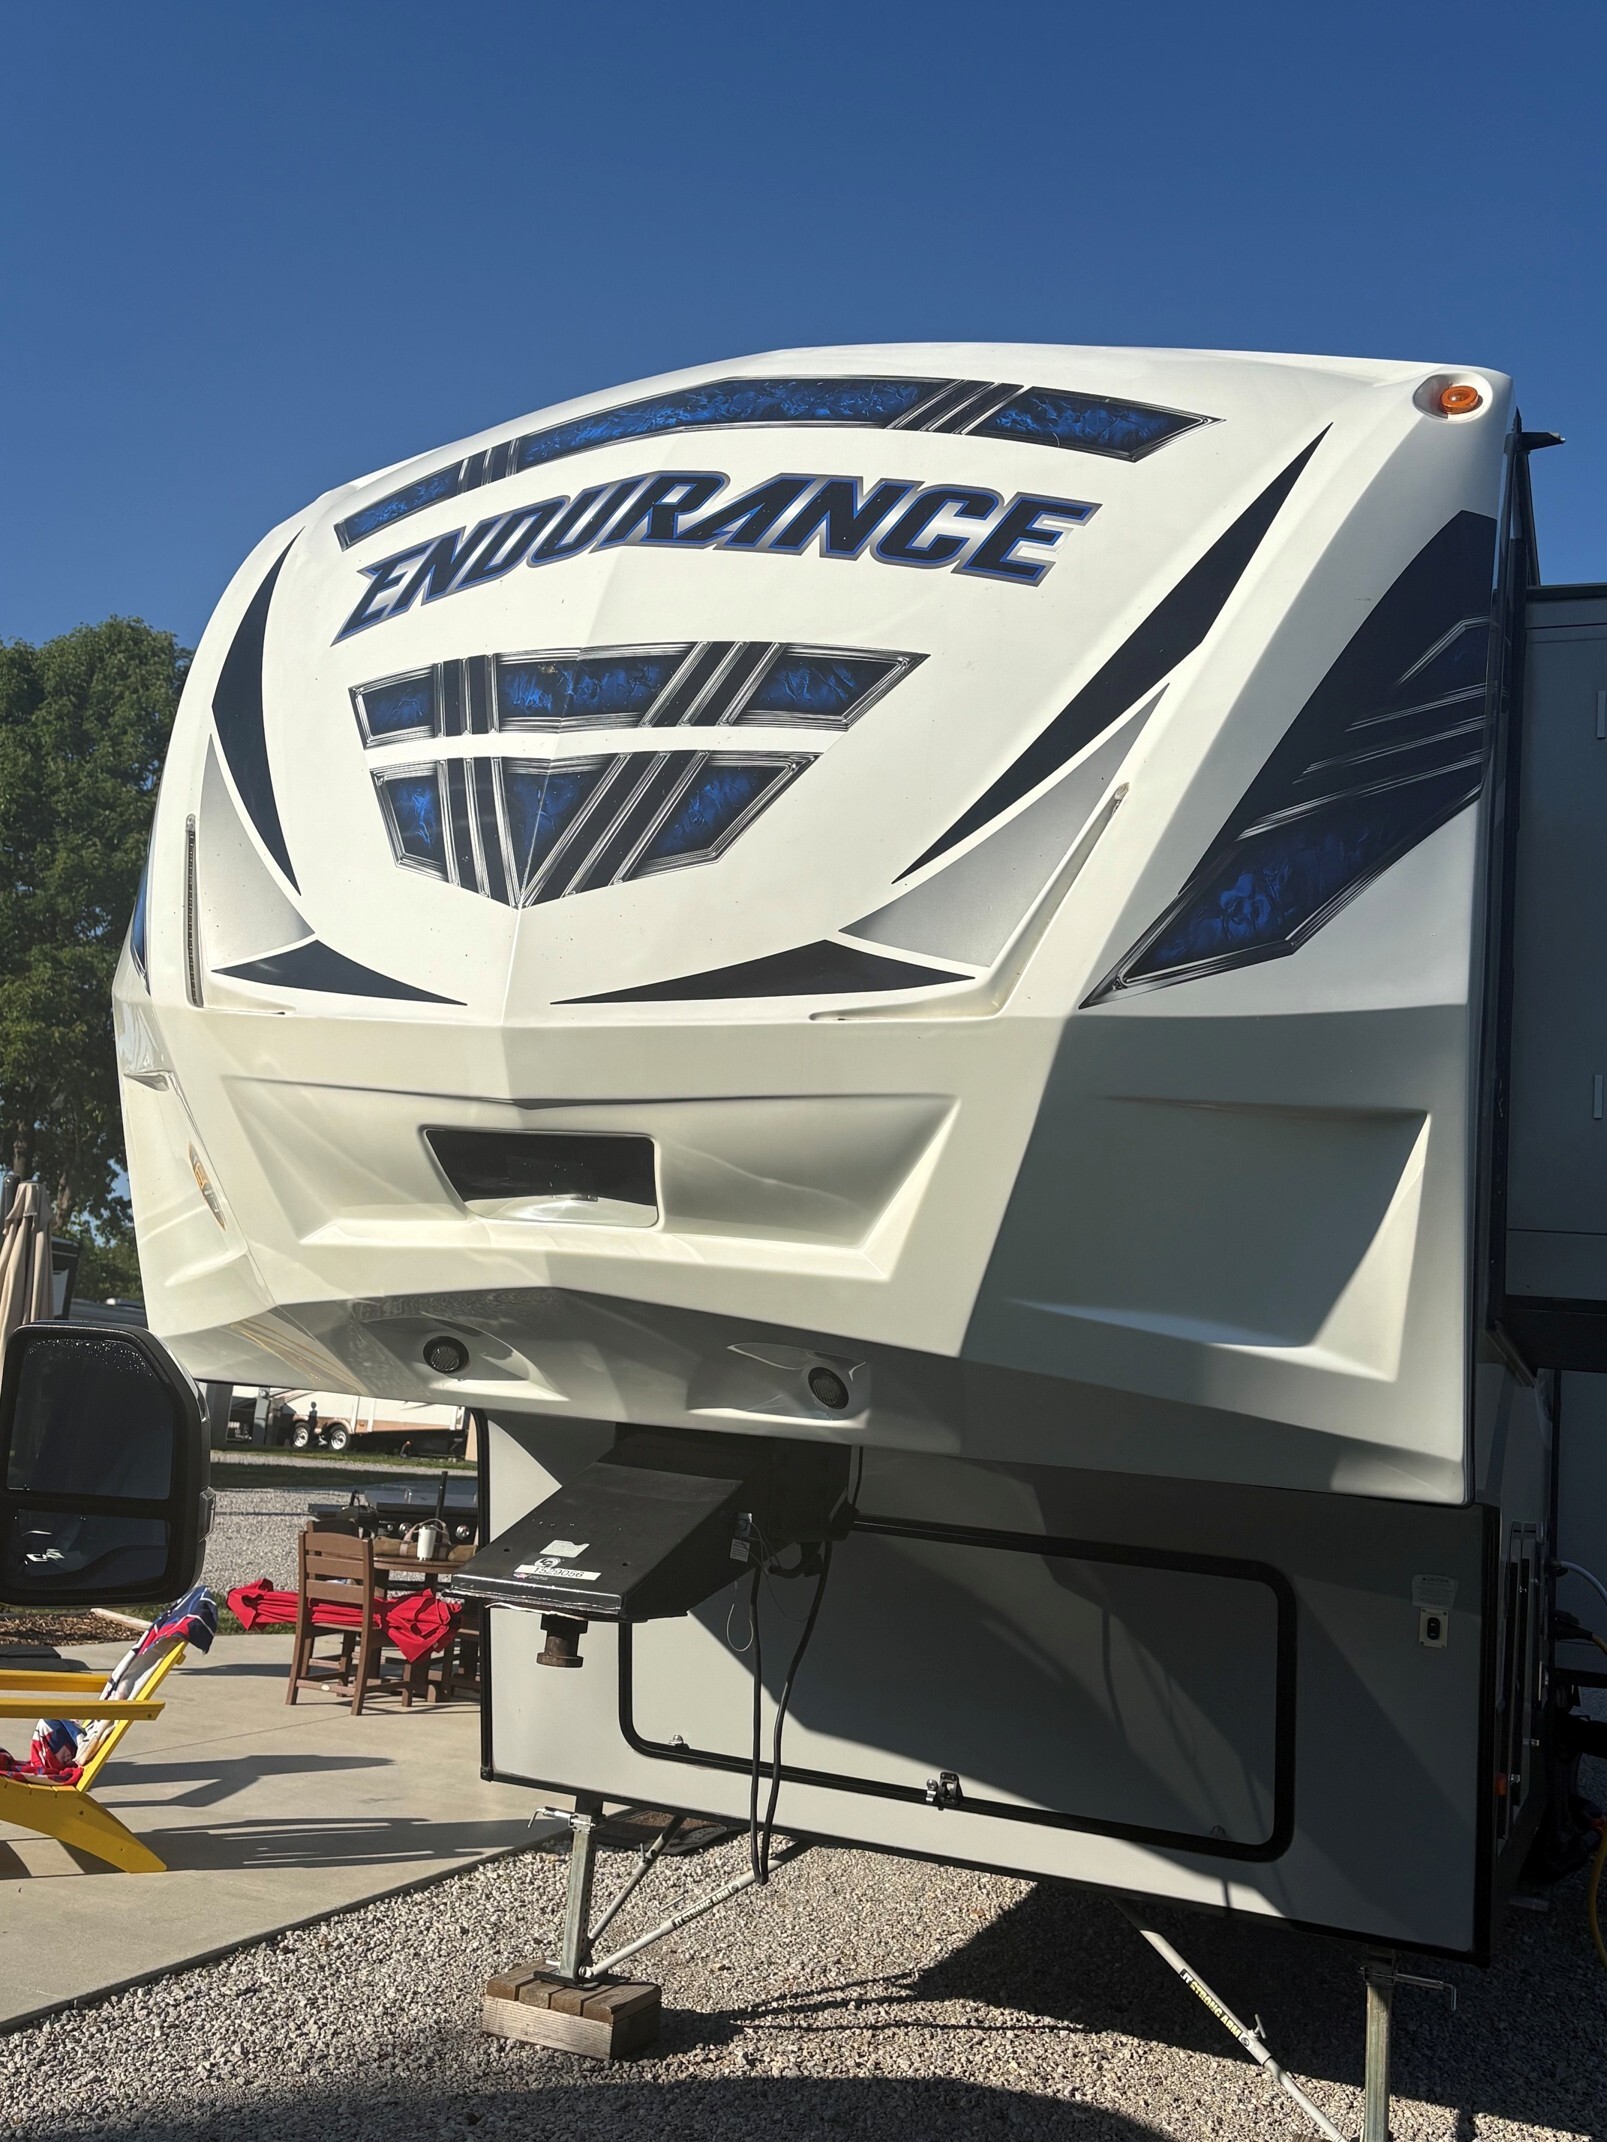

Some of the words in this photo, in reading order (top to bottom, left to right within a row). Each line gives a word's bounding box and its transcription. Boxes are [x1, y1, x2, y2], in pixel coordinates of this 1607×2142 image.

[332, 471, 1102, 646] ENDURANCE
[534, 1567, 584, 1578] 1529056
[682, 1899, 713, 1920] STRONG
[712, 1888, 731, 1904] ARM
[1190, 1981, 1222, 2018] STRONG
[1220, 2015, 1242, 2037] ARM
